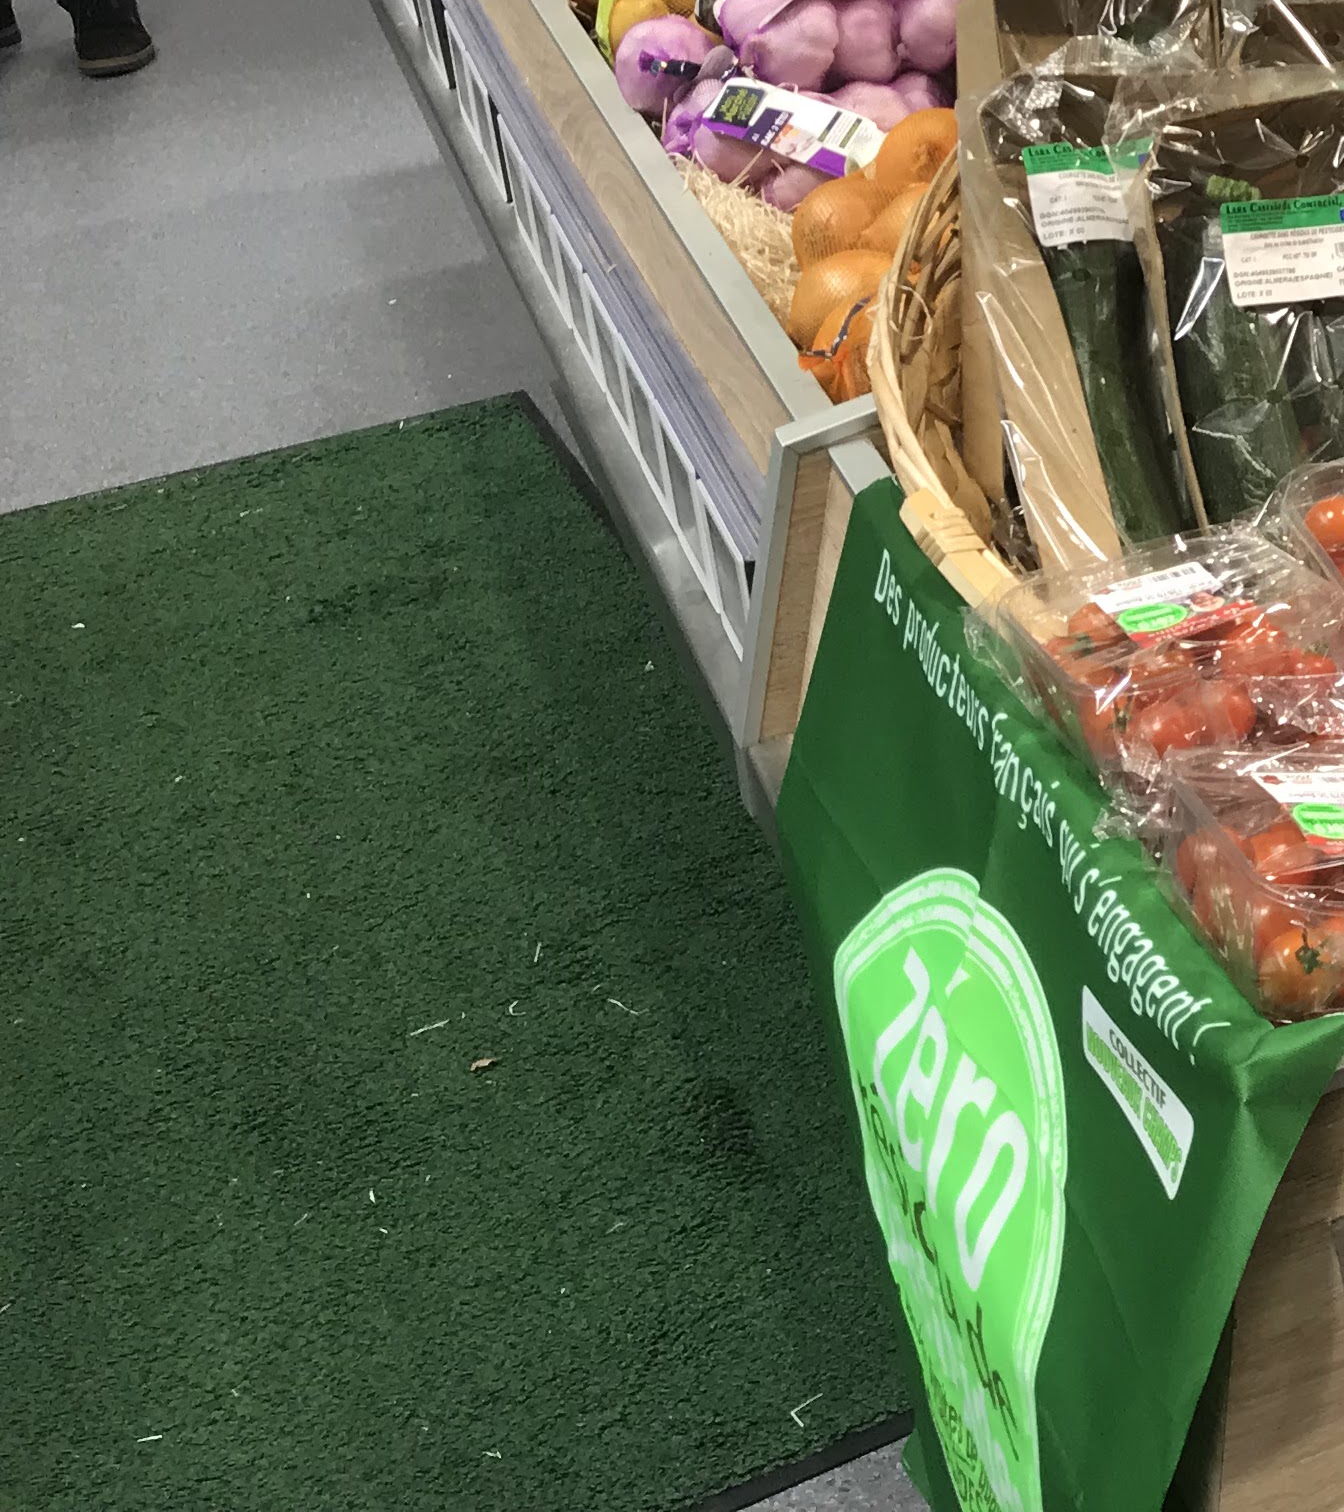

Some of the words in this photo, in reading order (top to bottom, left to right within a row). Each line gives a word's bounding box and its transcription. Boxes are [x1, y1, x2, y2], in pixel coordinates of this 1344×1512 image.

[875, 548, 904, 621] Des
[903, 607, 989, 752] producteurs
[991, 711, 1061, 849] français
[1059, 816, 1084, 881] qui
[1074, 840, 1213, 1052] s'engagent
[1109, 1028, 1167, 1109] COLLECTIF
